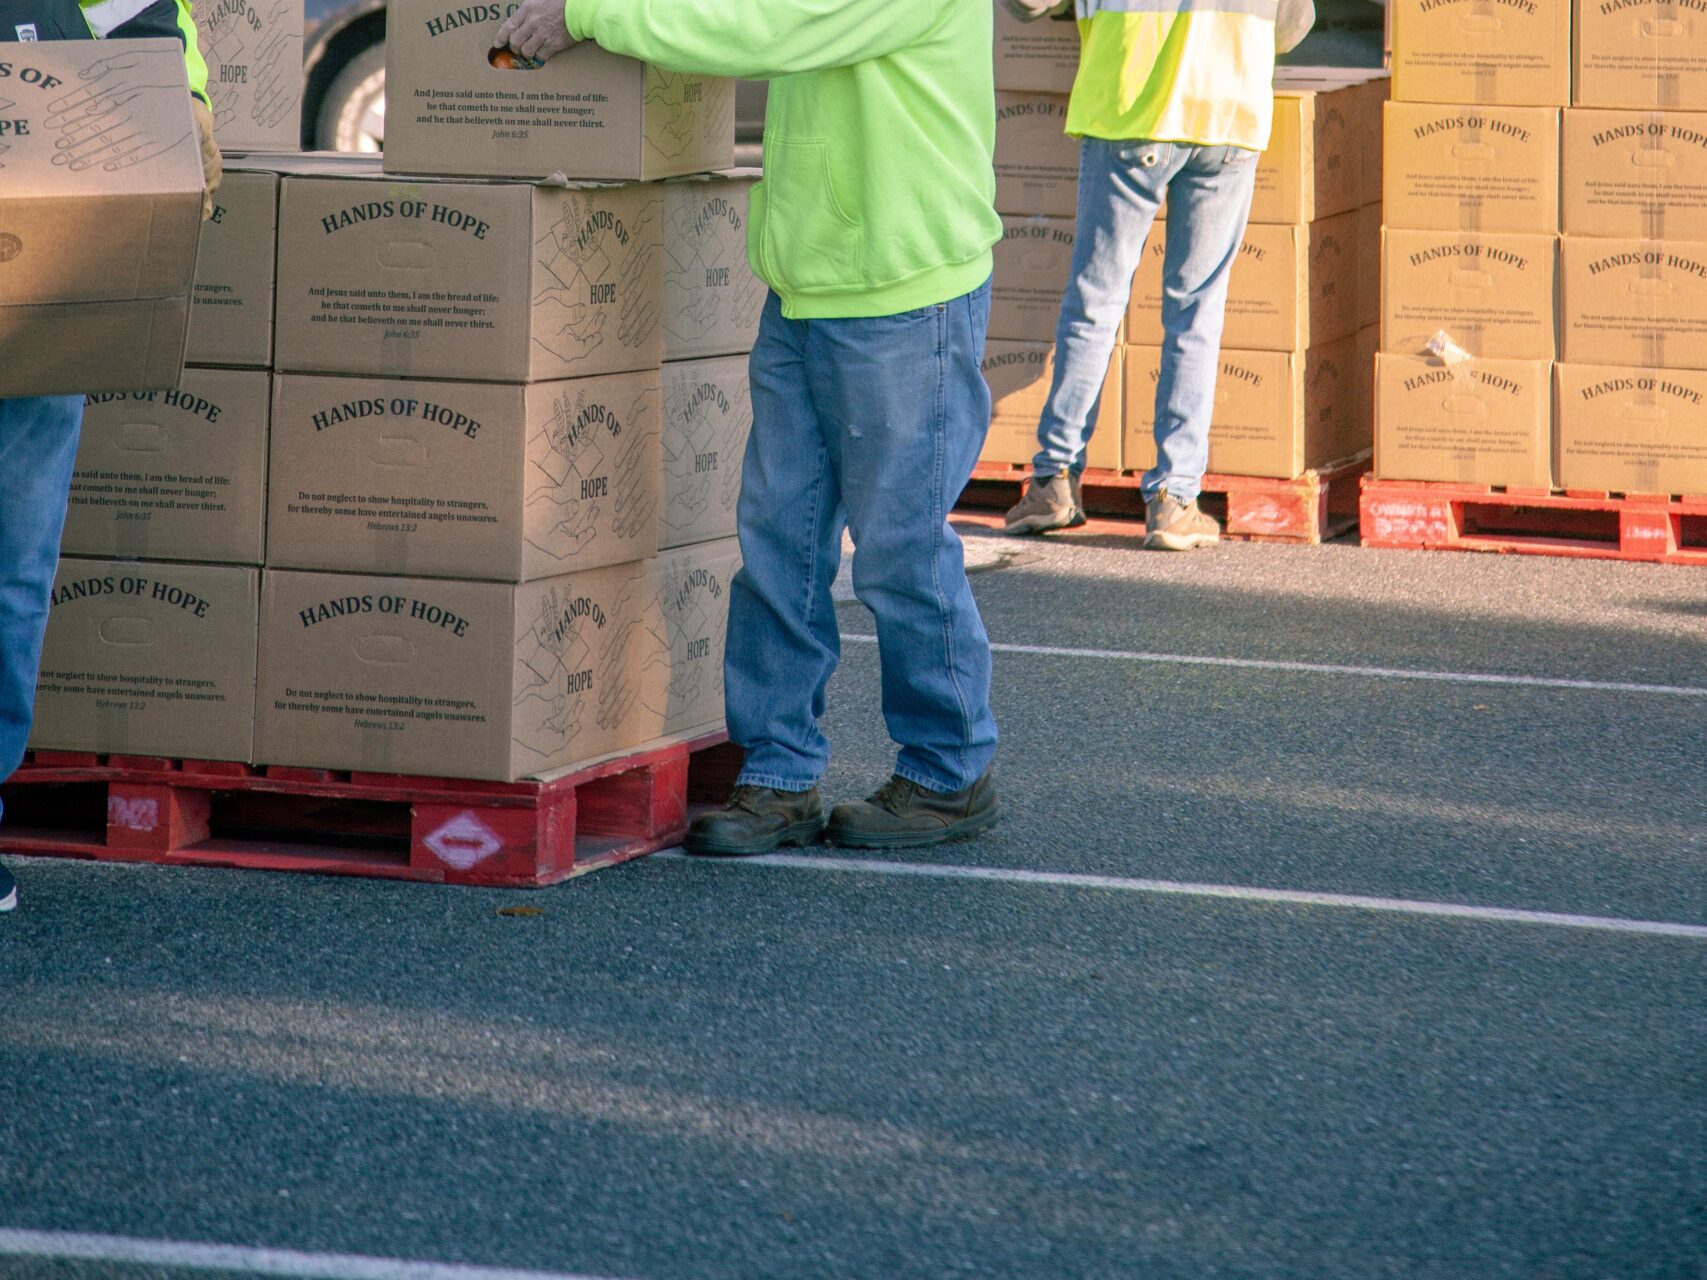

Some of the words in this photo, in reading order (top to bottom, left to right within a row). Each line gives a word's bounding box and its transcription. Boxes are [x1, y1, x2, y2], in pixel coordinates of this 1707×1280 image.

[248, 7, 262, 32] OF
[425, 3, 500, 37] HANDS
[20, 68, 63, 90] OF
[220, 64, 247, 83] HOPE
[414, 89, 430, 97] And
[432, 90, 453, 98] Jesus
[456, 90, 473, 98] said
[496, 91, 519, 100] them,
[556, 93, 580, 101] bread
[583, 93, 592, 101] of
[593, 93, 608, 102] life:
[684, 83, 702, 103] HOPE
[416, 115, 432, 123] and
[446, 116, 463, 124] that
[465, 117, 503, 125] believeth
[532, 118, 551, 126] shall
[427, 102, 437, 110] he
[439, 103, 456, 111] that
[458, 103, 488, 112] cometh
[515, 105, 535, 113] shall
[563, 106, 594, 116] hunger;
[997, 103, 1034, 120] ANDS
[1038, 103, 1056, 115] OF
[0, 120, 29, 136] PE
[492, 129, 509, 139] John
[512, 130, 528, 139] 6:35
[1414, 117, 1464, 139] HANDS
[1468, 117, 1487, 129] OF
[1489, 119, 1531, 143] HOPE
[1593, 124, 1644, 146] HANDS
[1648, 124, 1667, 135] OF
[321, 200, 394, 235] HANDS
[401, 200, 427, 218] OF
[431, 204, 490, 240] HOPE
[694, 198, 727, 236] HANDS
[729, 207, 741, 231] OF
[576, 210, 613, 251] HANDS
[615, 219, 629, 246] OF
[1002, 227, 1027, 241] NDS
[1032, 226, 1050, 239] OF
[1410, 245, 1460, 267] HANDS
[1464, 245, 1484, 256] OF
[1487, 247, 1528, 271] HOPE
[1589, 252, 1641, 275] HANDS
[1644, 252, 1664, 264] OF
[706, 268, 729, 287] HOPE
[590, 283, 616, 304] HOPE
[1223, 364, 1263, 387] HOPE
[1404, 370, 1455, 392] HANDS
[1481, 373, 1523, 397] HOPE
[1582, 378, 1634, 401] HANDS
[1637, 378, 1656, 390] OF
[1660, 381, 1703, 405] HOPE
[164, 390, 222, 423] HOPE
[684, 383, 716, 424] HANDS
[717, 390, 729, 415] OF
[311, 399, 385, 432] HANDS
[390, 399, 418, 416] OF
[423, 402, 480, 439] HOPE
[567, 404, 605, 447] HANDS
[607, 412, 621, 438] OF
[695, 452, 718, 473] HOPE
[299, 492, 309, 501] Do
[327, 494, 356, 504] neglect
[368, 495, 389, 504] show
[391, 496, 435, 507] hospitality
[437, 499, 444, 507] to
[581, 477, 608, 499] HOPE
[288, 505, 299, 513] for
[302, 505, 332, 515] thereby
[358, 508, 376, 517] have
[378, 510, 426, 519] entertained
[428, 512, 454, 521] angels
[457, 514, 499, 523] unawares.
[120, 577, 148, 596] OF
[152, 581, 210, 618] HOPE
[676, 569, 707, 611] HANDS
[709, 575, 721, 600] OF
[299, 595, 372, 629] HANDS
[379, 595, 406, 614] OF
[410, 600, 469, 638] HOPE
[554, 597, 591, 643] HANDS
[592, 603, 606, 630] OF
[687, 638, 709, 660] HOPE
[567, 669, 593, 694] HOPE
